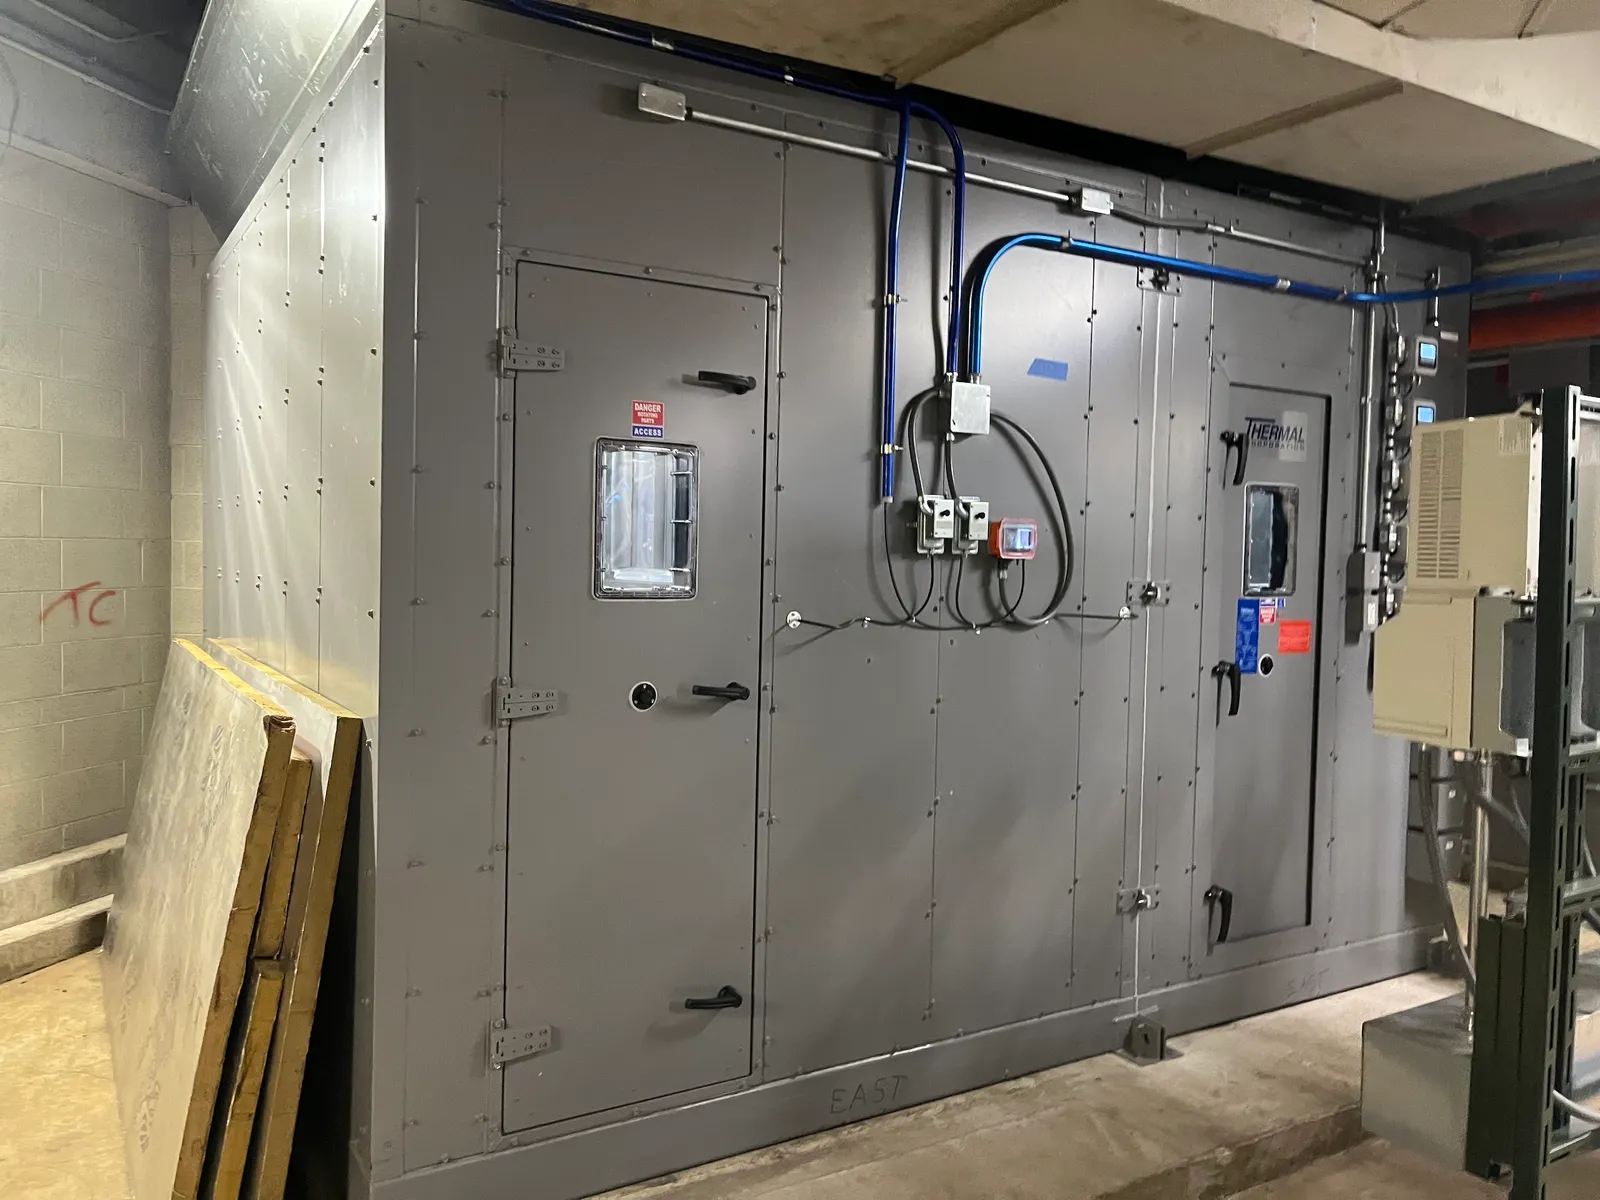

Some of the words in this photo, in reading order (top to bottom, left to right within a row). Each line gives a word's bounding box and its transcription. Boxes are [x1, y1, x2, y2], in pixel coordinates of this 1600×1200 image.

[634, 402, 662, 413] DANGER
[634, 427, 662, 437] ACCESS
[1245, 416, 1304, 443] THERMAL
[39, 581, 116, 627] TC
[830, 1075, 908, 1115] EAST
